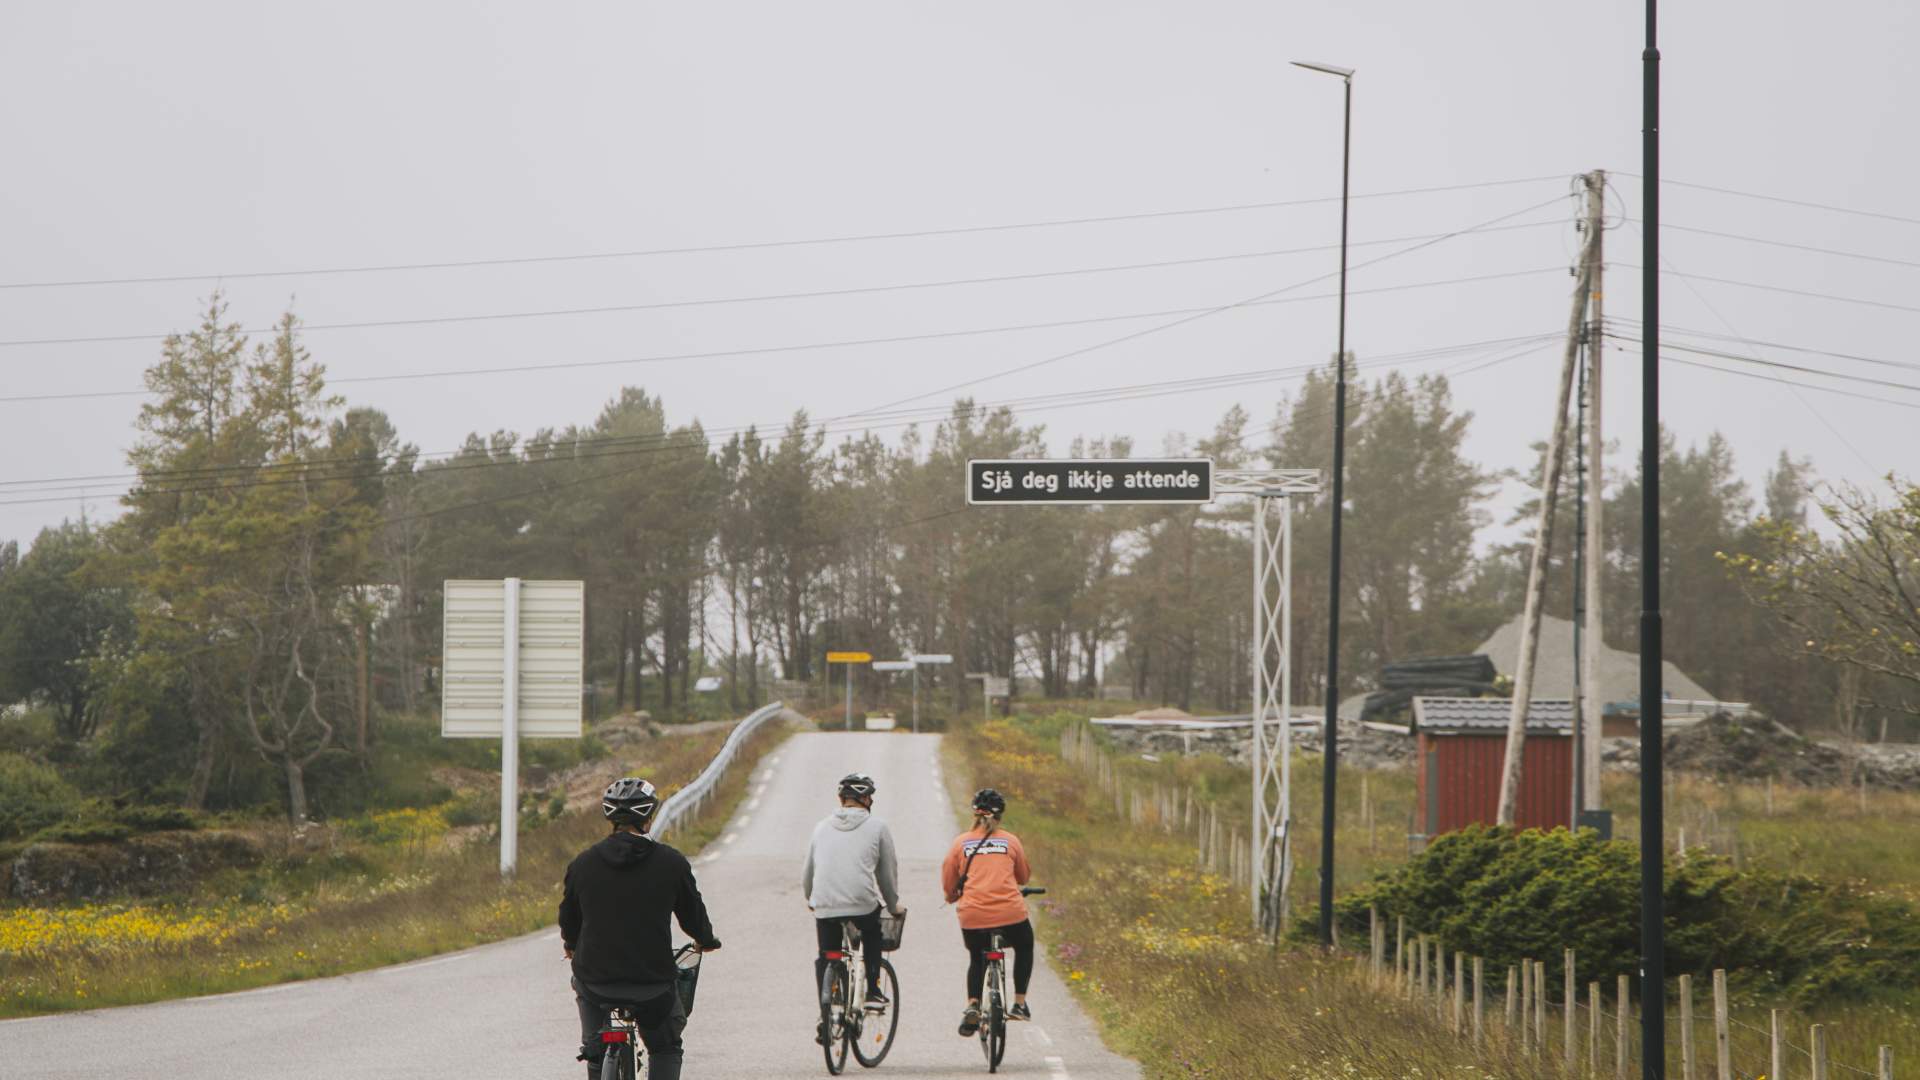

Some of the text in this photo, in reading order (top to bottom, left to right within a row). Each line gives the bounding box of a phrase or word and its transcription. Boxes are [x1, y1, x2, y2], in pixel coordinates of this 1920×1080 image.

[981, 470, 1200, 493] Sjå deg ikkje attende
